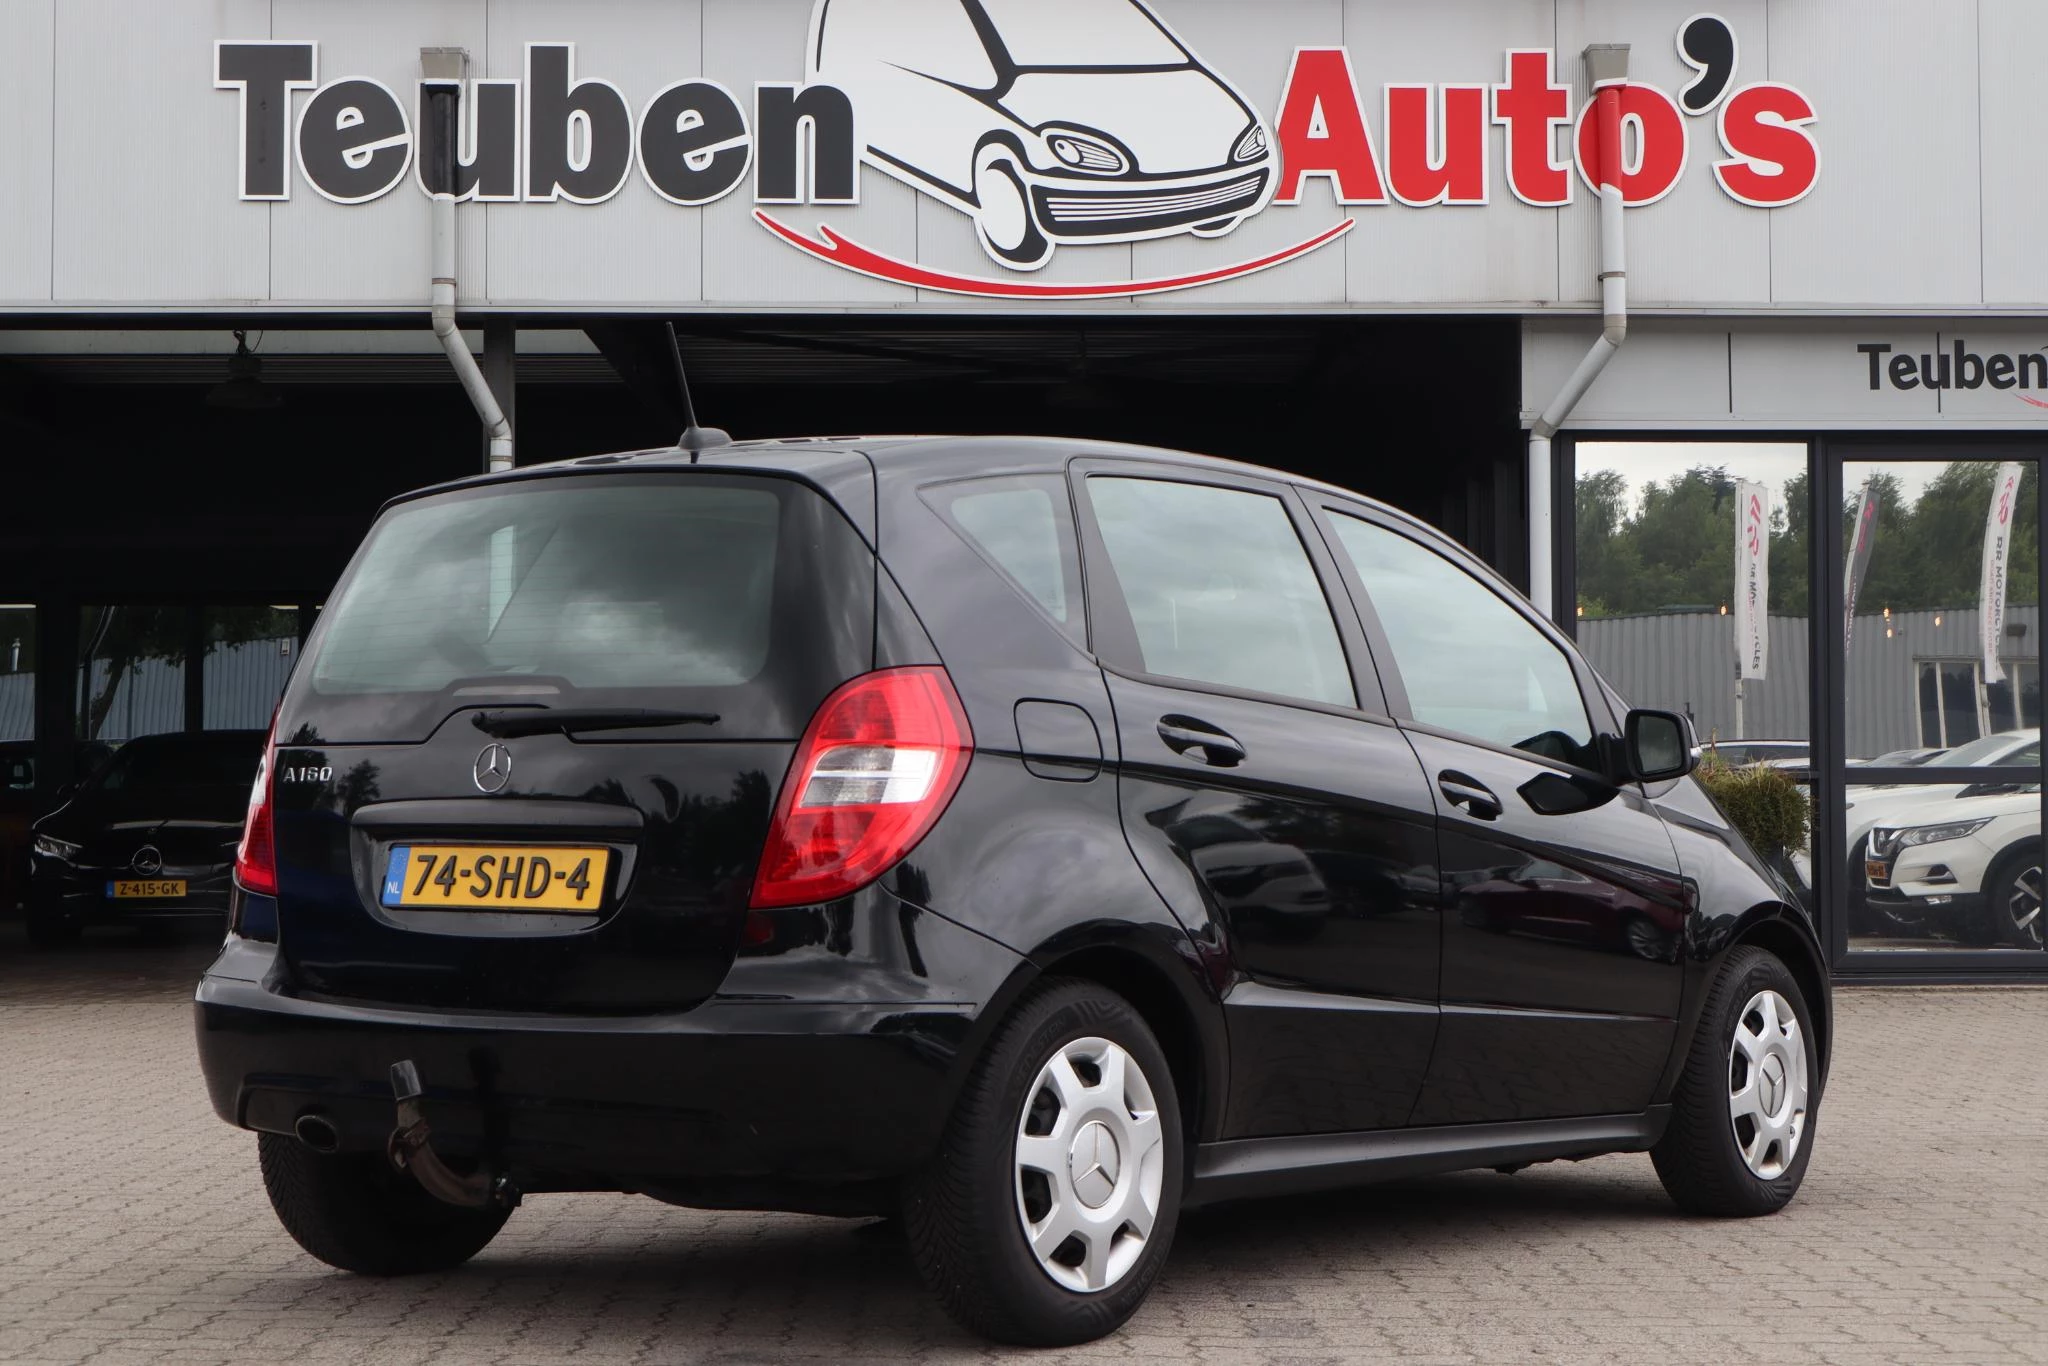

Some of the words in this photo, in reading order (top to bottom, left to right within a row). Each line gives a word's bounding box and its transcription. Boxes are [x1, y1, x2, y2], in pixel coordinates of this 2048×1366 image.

[214, 40, 860, 205] Teuben
[1273, 13, 1820, 207] Auto's
[1856, 339, 2048, 391] Teuben
[120, 882, 180, 896] Z-415-GK
[386, 881, 400, 894] NL
[412, 854, 591, 901] 74-SHD-4
